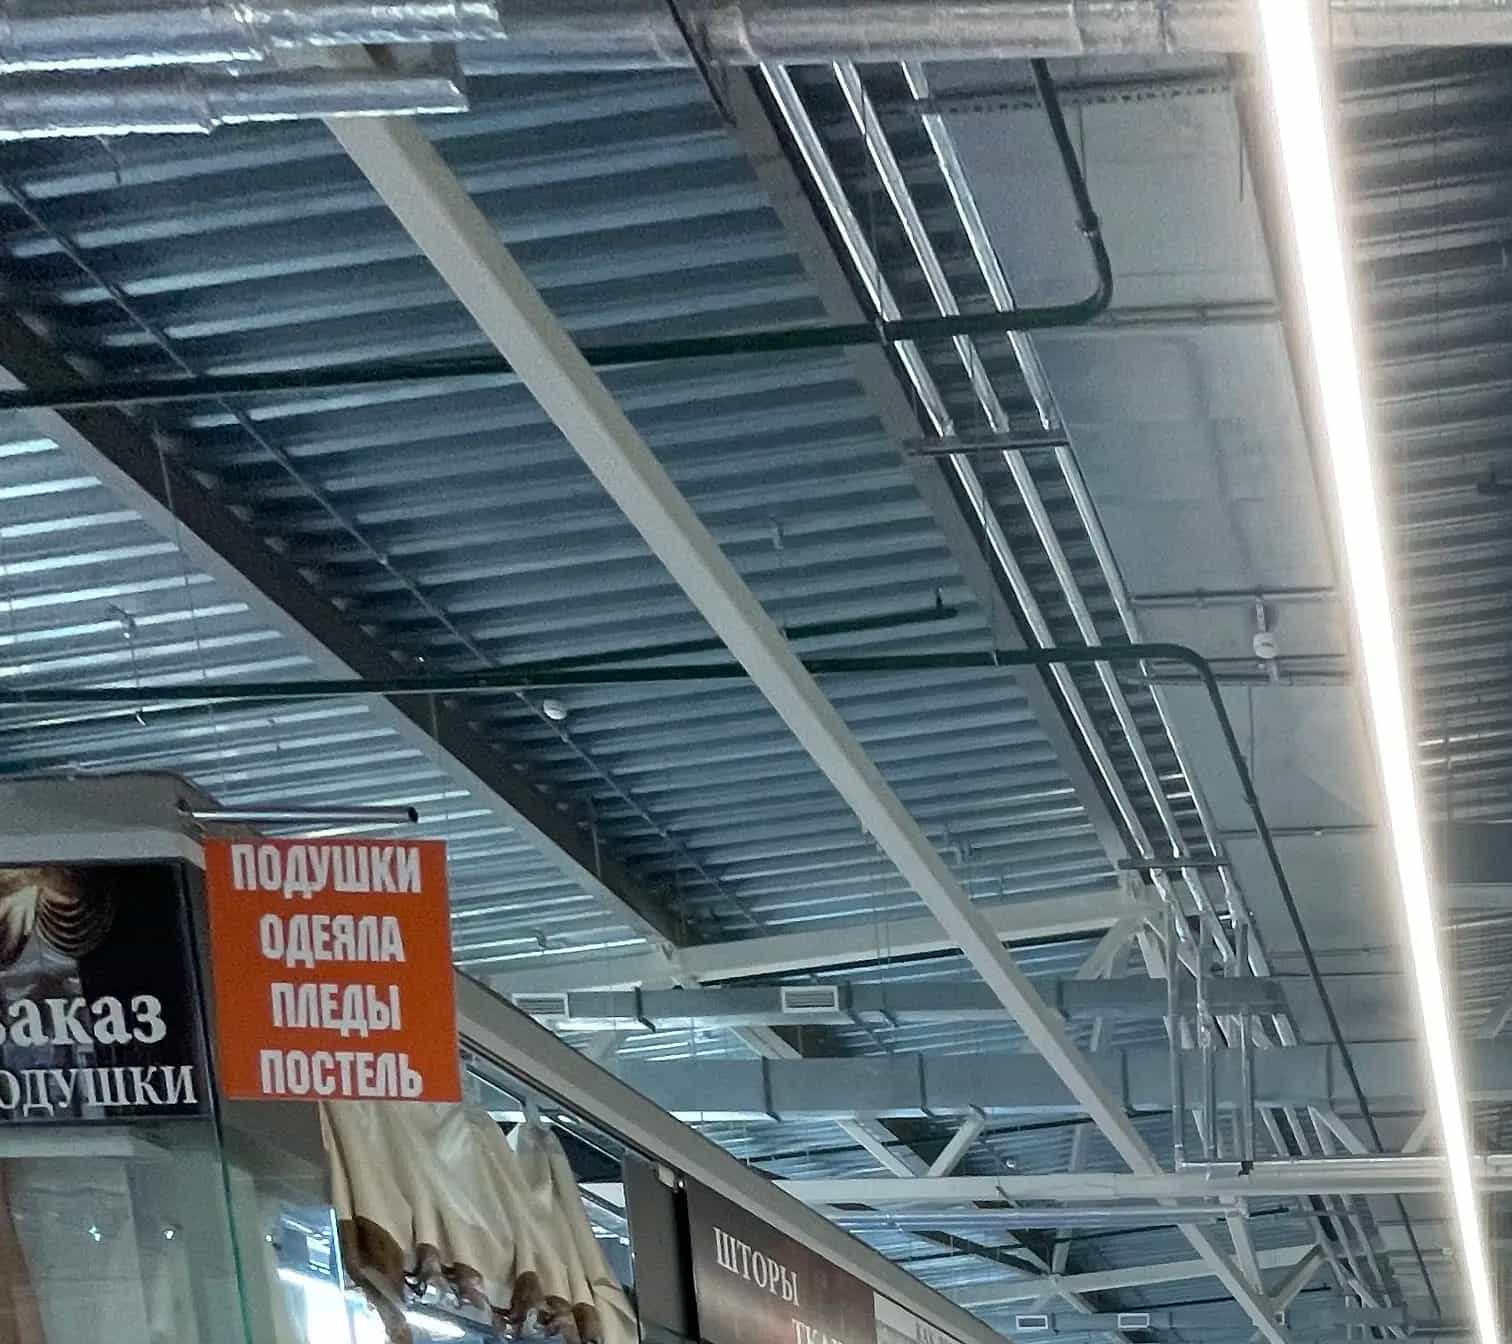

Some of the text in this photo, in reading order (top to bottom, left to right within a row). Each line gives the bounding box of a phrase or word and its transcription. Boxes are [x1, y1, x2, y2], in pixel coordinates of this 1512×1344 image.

[230, 843, 423, 899] ПОДУШКИ
[259, 914, 407, 969] ОДЕЯЛА
[0, 994, 168, 1047] аказ
[270, 982, 402, 1038] ПЛЕДЫ
[259, 1048, 424, 1099] ПОСТЕЛЬ
[712, 1226, 800, 1306] ШТОРЫ
